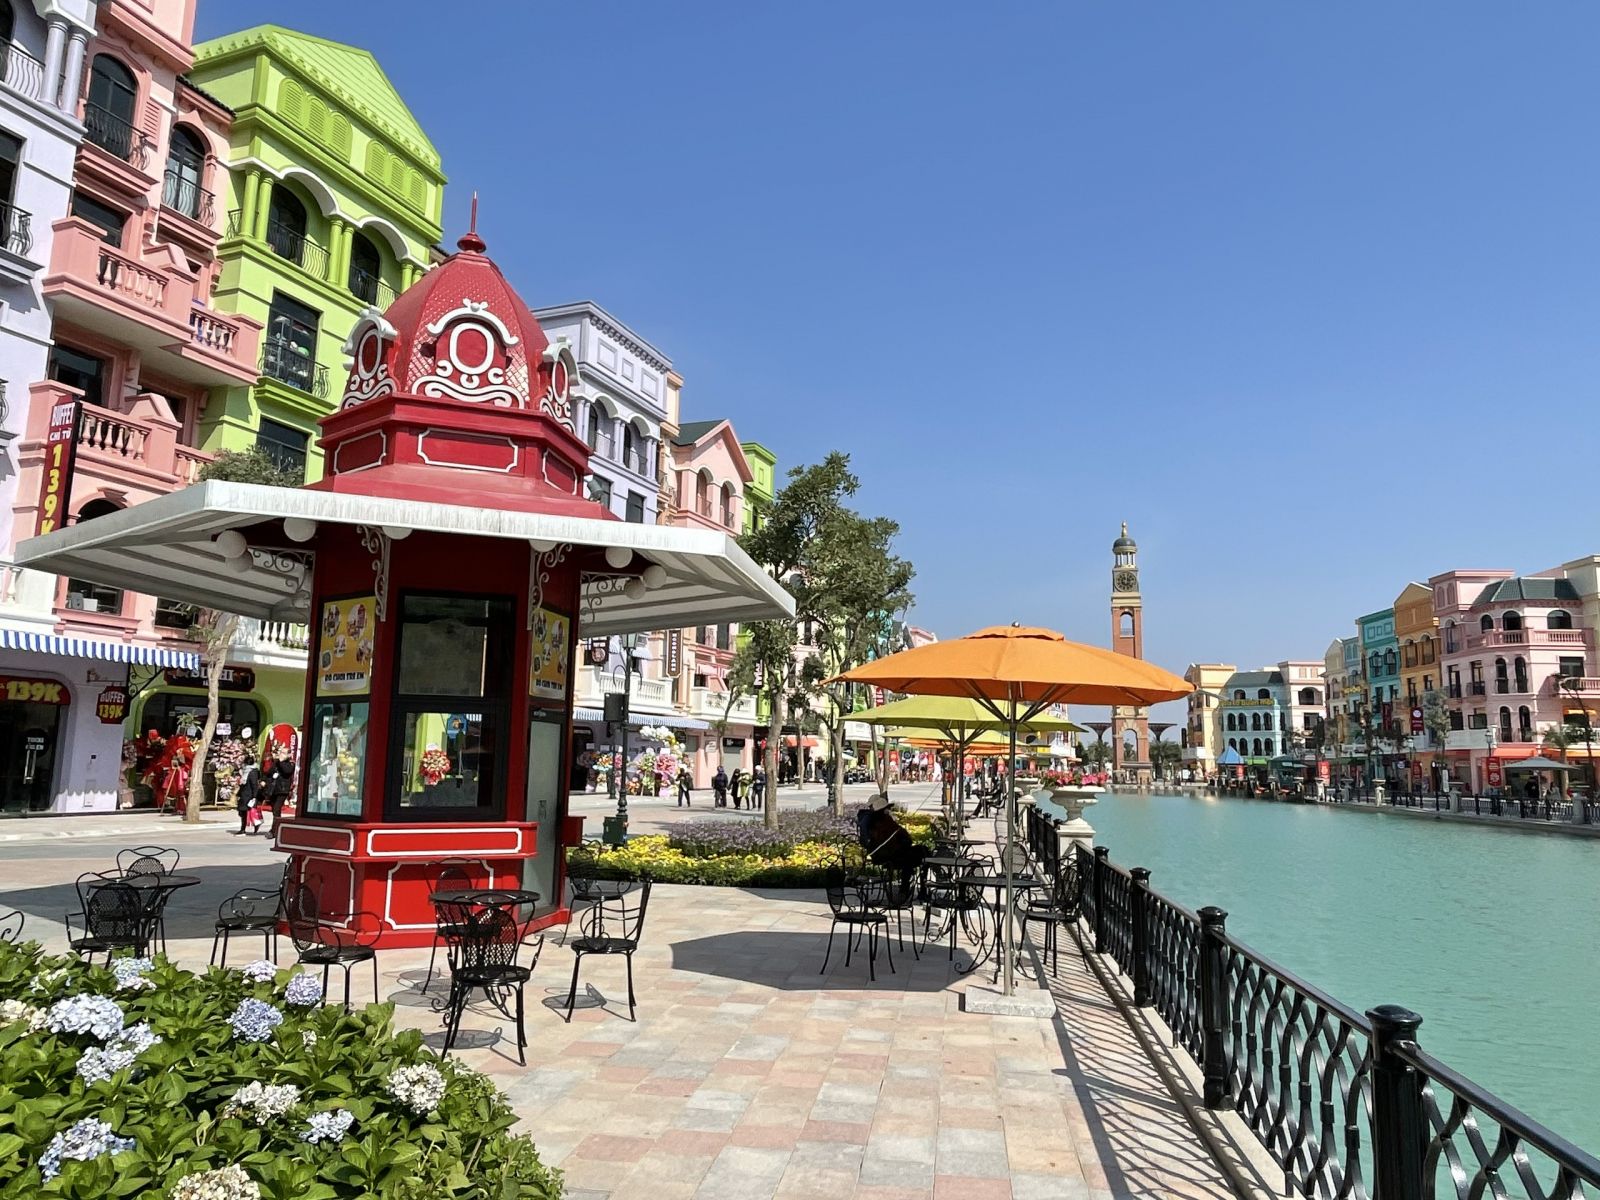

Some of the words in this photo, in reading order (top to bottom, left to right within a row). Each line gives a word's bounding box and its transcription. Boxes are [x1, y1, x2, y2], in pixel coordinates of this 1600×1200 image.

[51, 402, 75, 426] BUFFET
[191, 667, 234, 682] SUHI
[7, 680, 62, 703] 139K
[100, 691, 125, 703] BUFFET
[99, 704, 124, 719] 139K
